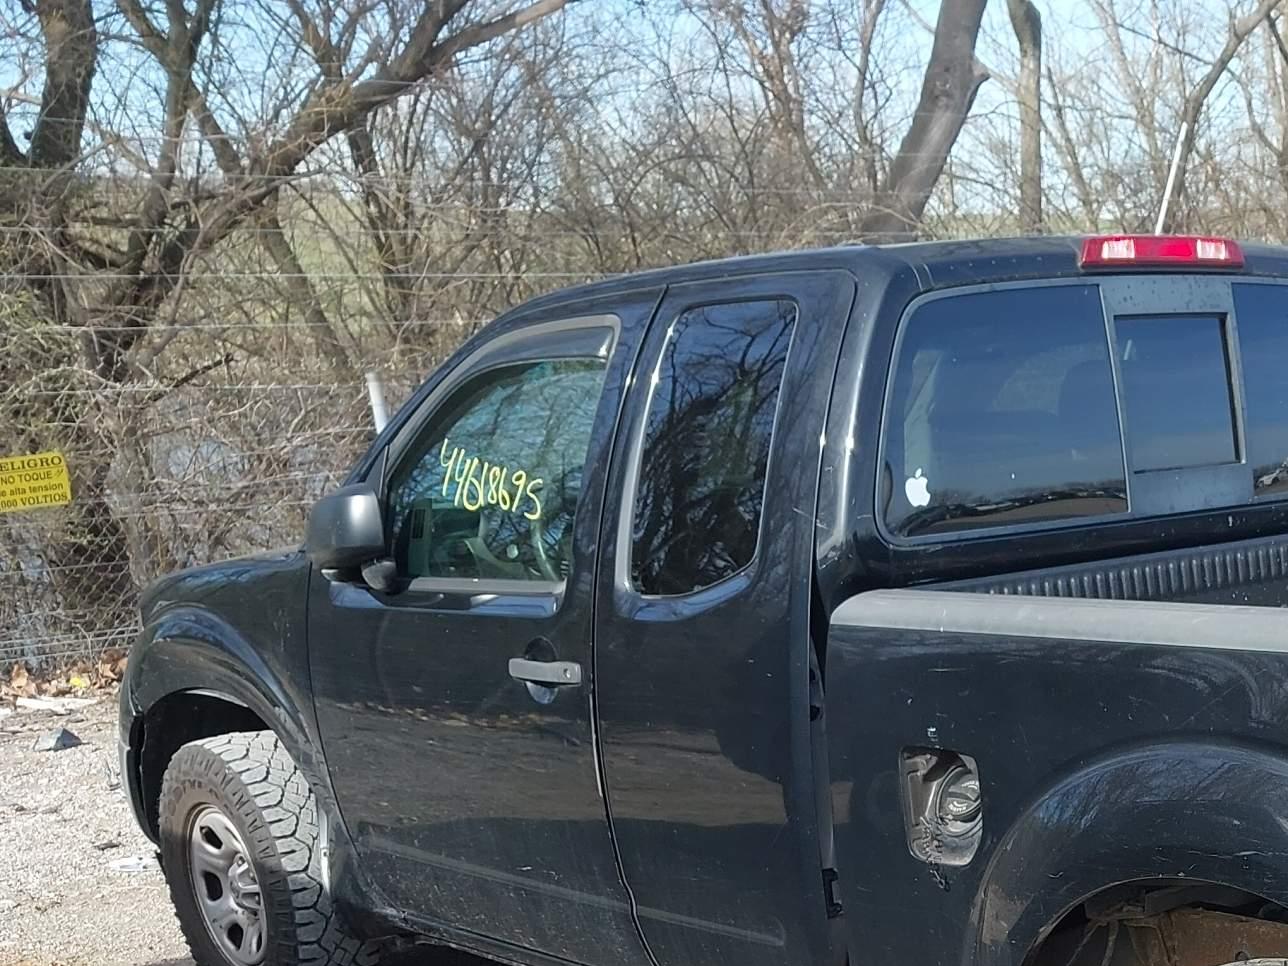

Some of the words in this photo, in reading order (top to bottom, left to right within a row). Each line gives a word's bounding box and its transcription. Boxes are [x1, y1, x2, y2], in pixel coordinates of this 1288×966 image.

[0, 455, 62, 471] ELIGRO
[1, 475, 15, 485] NO
[16, 470, 53, 483] TOQUE
[440, 438, 543, 520] 44618695
[10, 487, 26, 496] alta
[0, 499, 17, 509] 000
[20, 492, 68, 506] VOLTIOS
